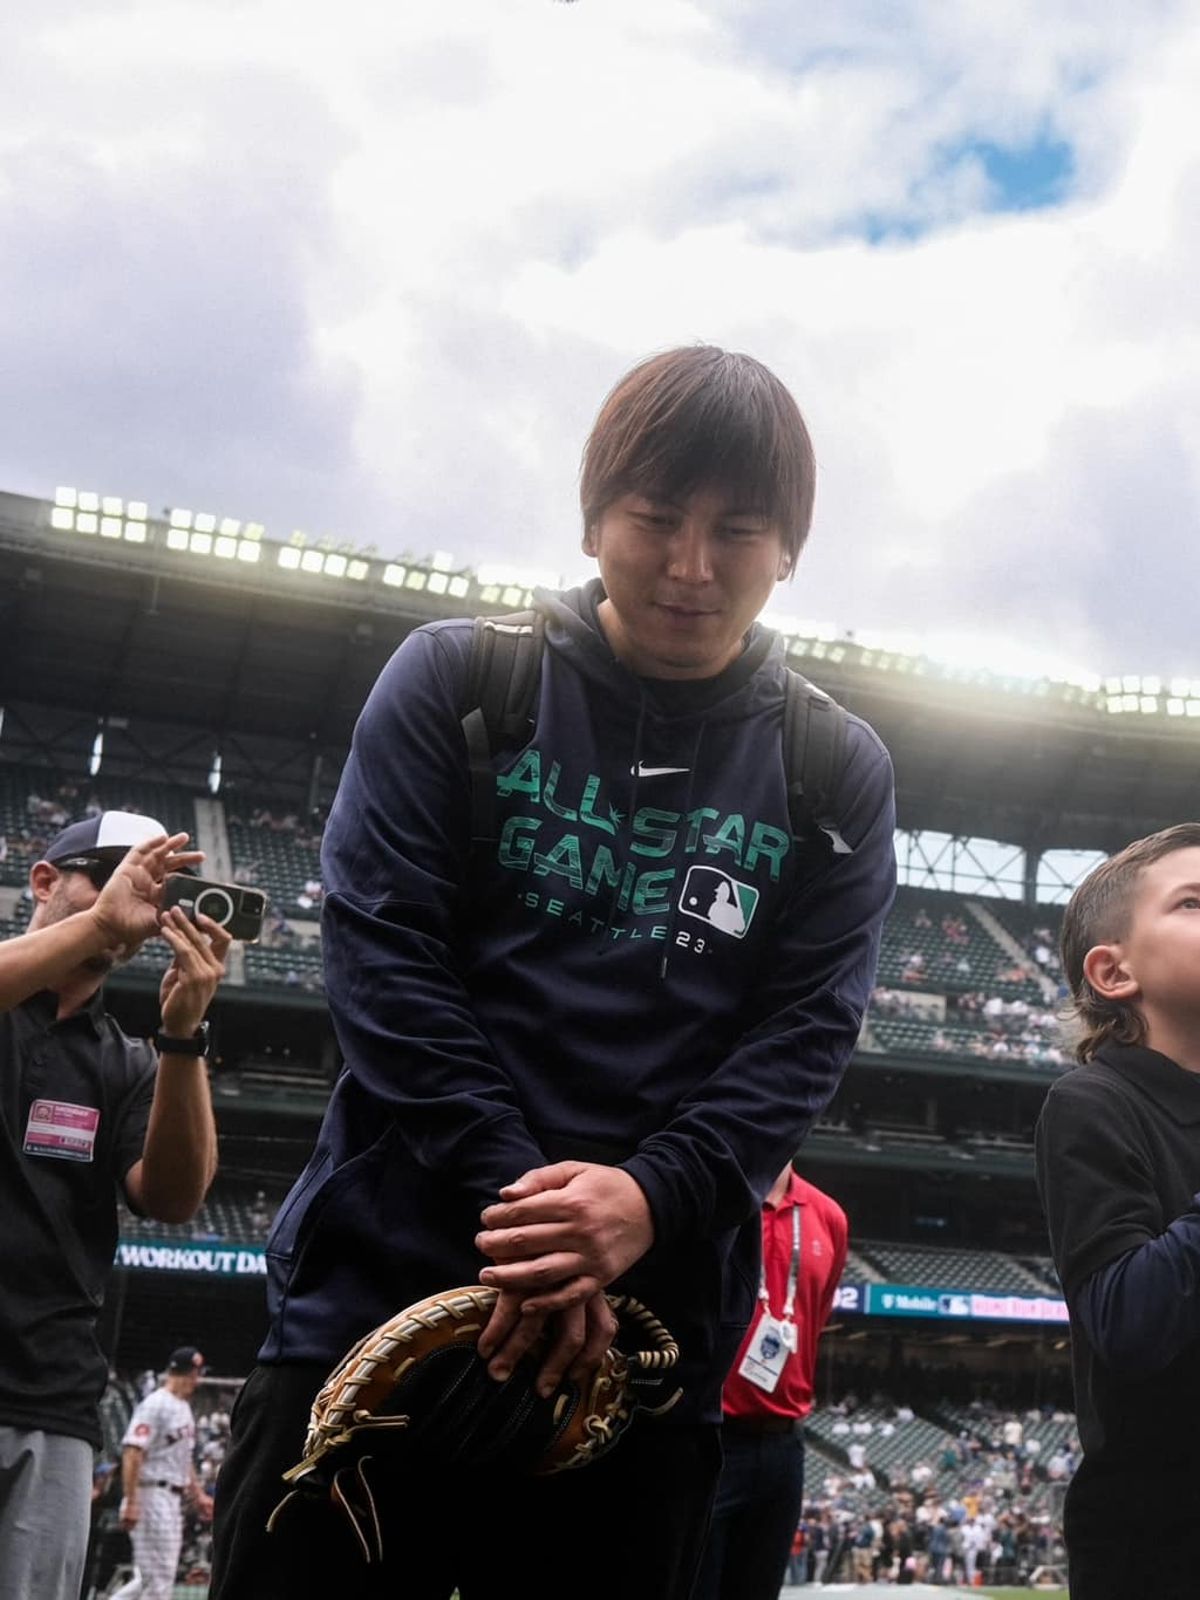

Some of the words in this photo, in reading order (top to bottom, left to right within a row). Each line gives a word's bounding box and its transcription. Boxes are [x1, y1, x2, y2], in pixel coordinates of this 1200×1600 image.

[498, 816, 676, 916] GAME
[524, 892, 668, 940] SEATTLE
[675, 931, 706, 954] 23
[120, 1244, 233, 1272] WORKOUT
